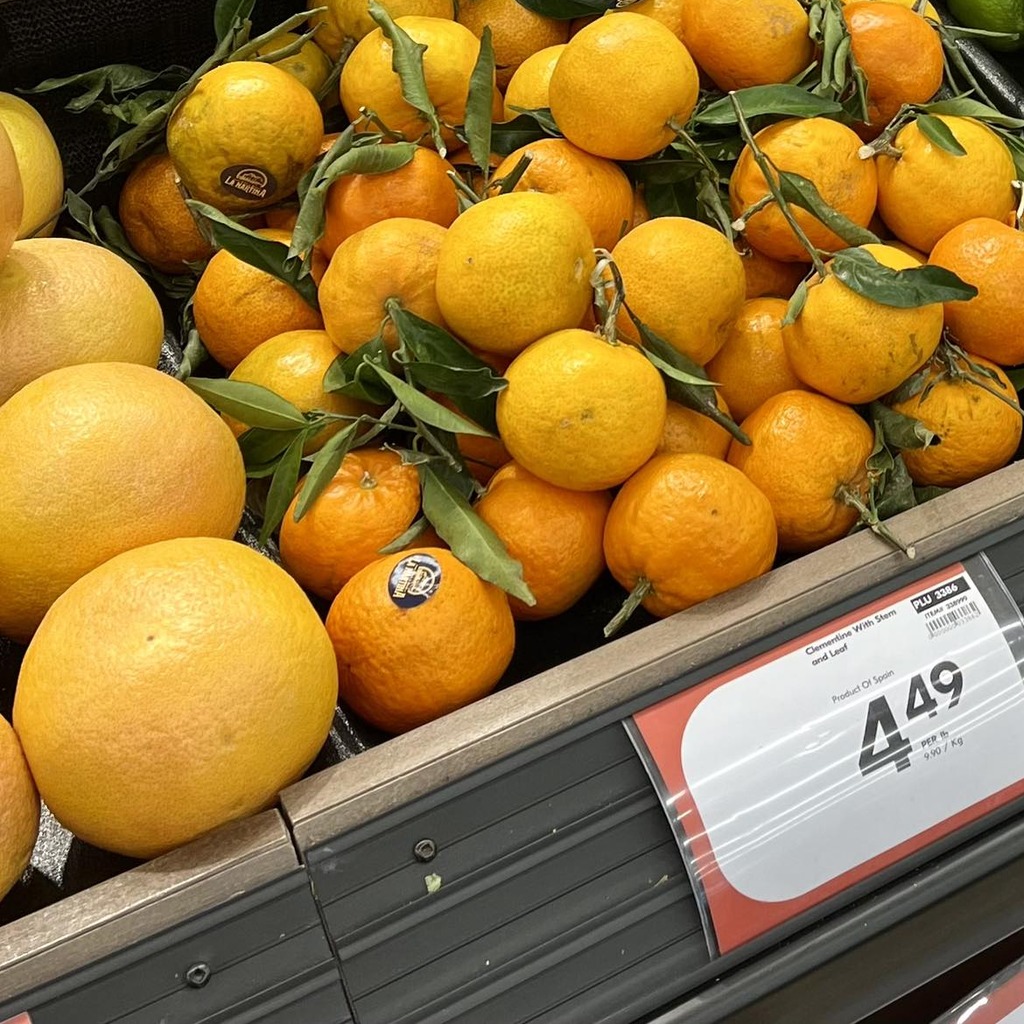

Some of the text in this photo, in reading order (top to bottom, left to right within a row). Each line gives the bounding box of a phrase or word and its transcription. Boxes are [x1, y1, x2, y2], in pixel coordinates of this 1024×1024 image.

[912, 582, 959, 610] PLU 3386
[805, 608, 897, 656] Clementine With Stem
[811, 642, 849, 666] and Leaf
[831, 668, 895, 704] Product Of Spain
[920, 736, 939, 749] PER
[923, 746, 942, 761] 9.90
[951, 737, 964, 751] Kg
